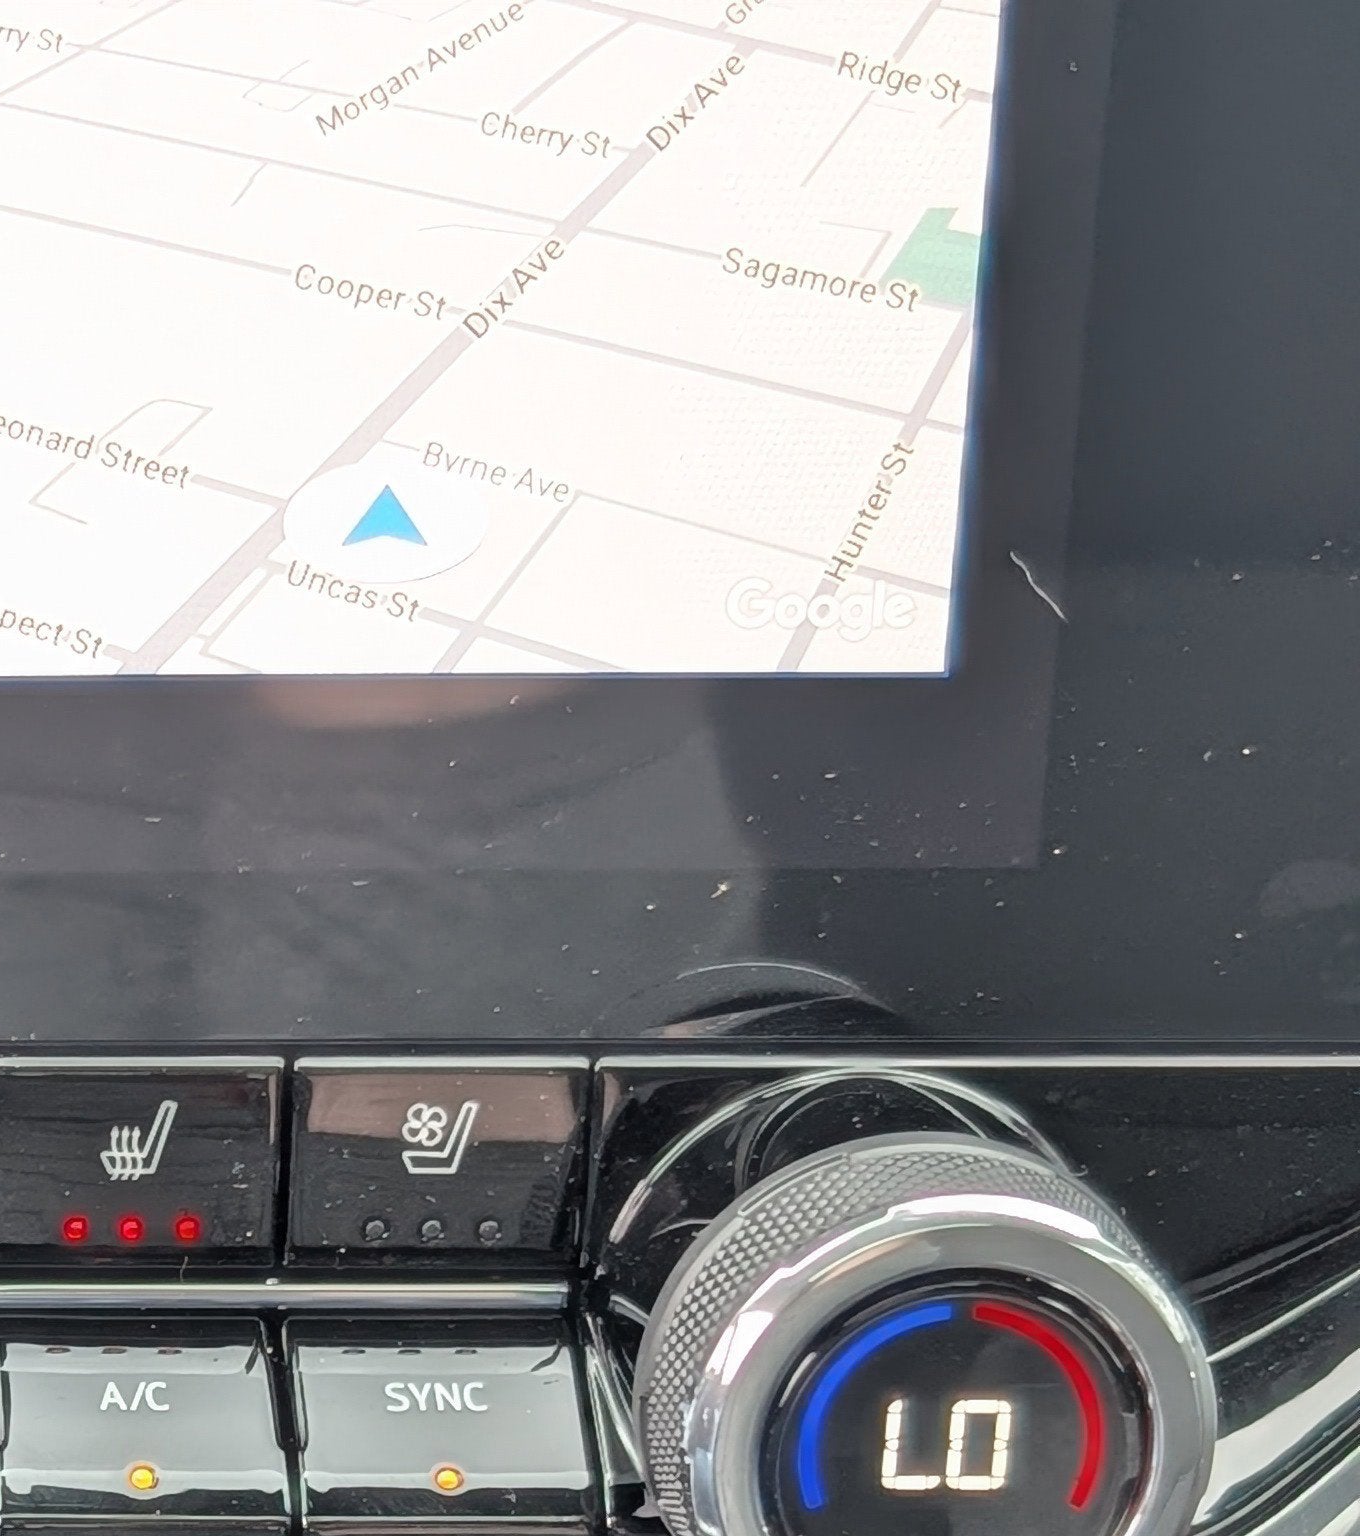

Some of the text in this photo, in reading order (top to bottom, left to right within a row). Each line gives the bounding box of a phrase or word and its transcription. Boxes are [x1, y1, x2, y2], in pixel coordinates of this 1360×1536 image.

[35, 28, 62, 53] St
[315, 3, 524, 136] Morgan Avenue
[837, 51, 961, 103] Ridge St
[646, 55, 746, 152] Dix Ave
[481, 111, 611, 158] Cherry St
[295, 264, 446, 320] Cooper St
[462, 238, 565, 338] Dix Ave
[722, 247, 920, 312] Sagamore St
[100, 442, 191, 489] Street
[513, 467, 570, 503] Ave
[824, 441, 914, 583] Hunter St
[287, 559, 421, 622] Uncas St
[725, 576, 918, 643] Google
[70, 628, 104, 659] St
[98, 1380, 170, 1414] A/C
[383, 1380, 489, 1414] SYNC
